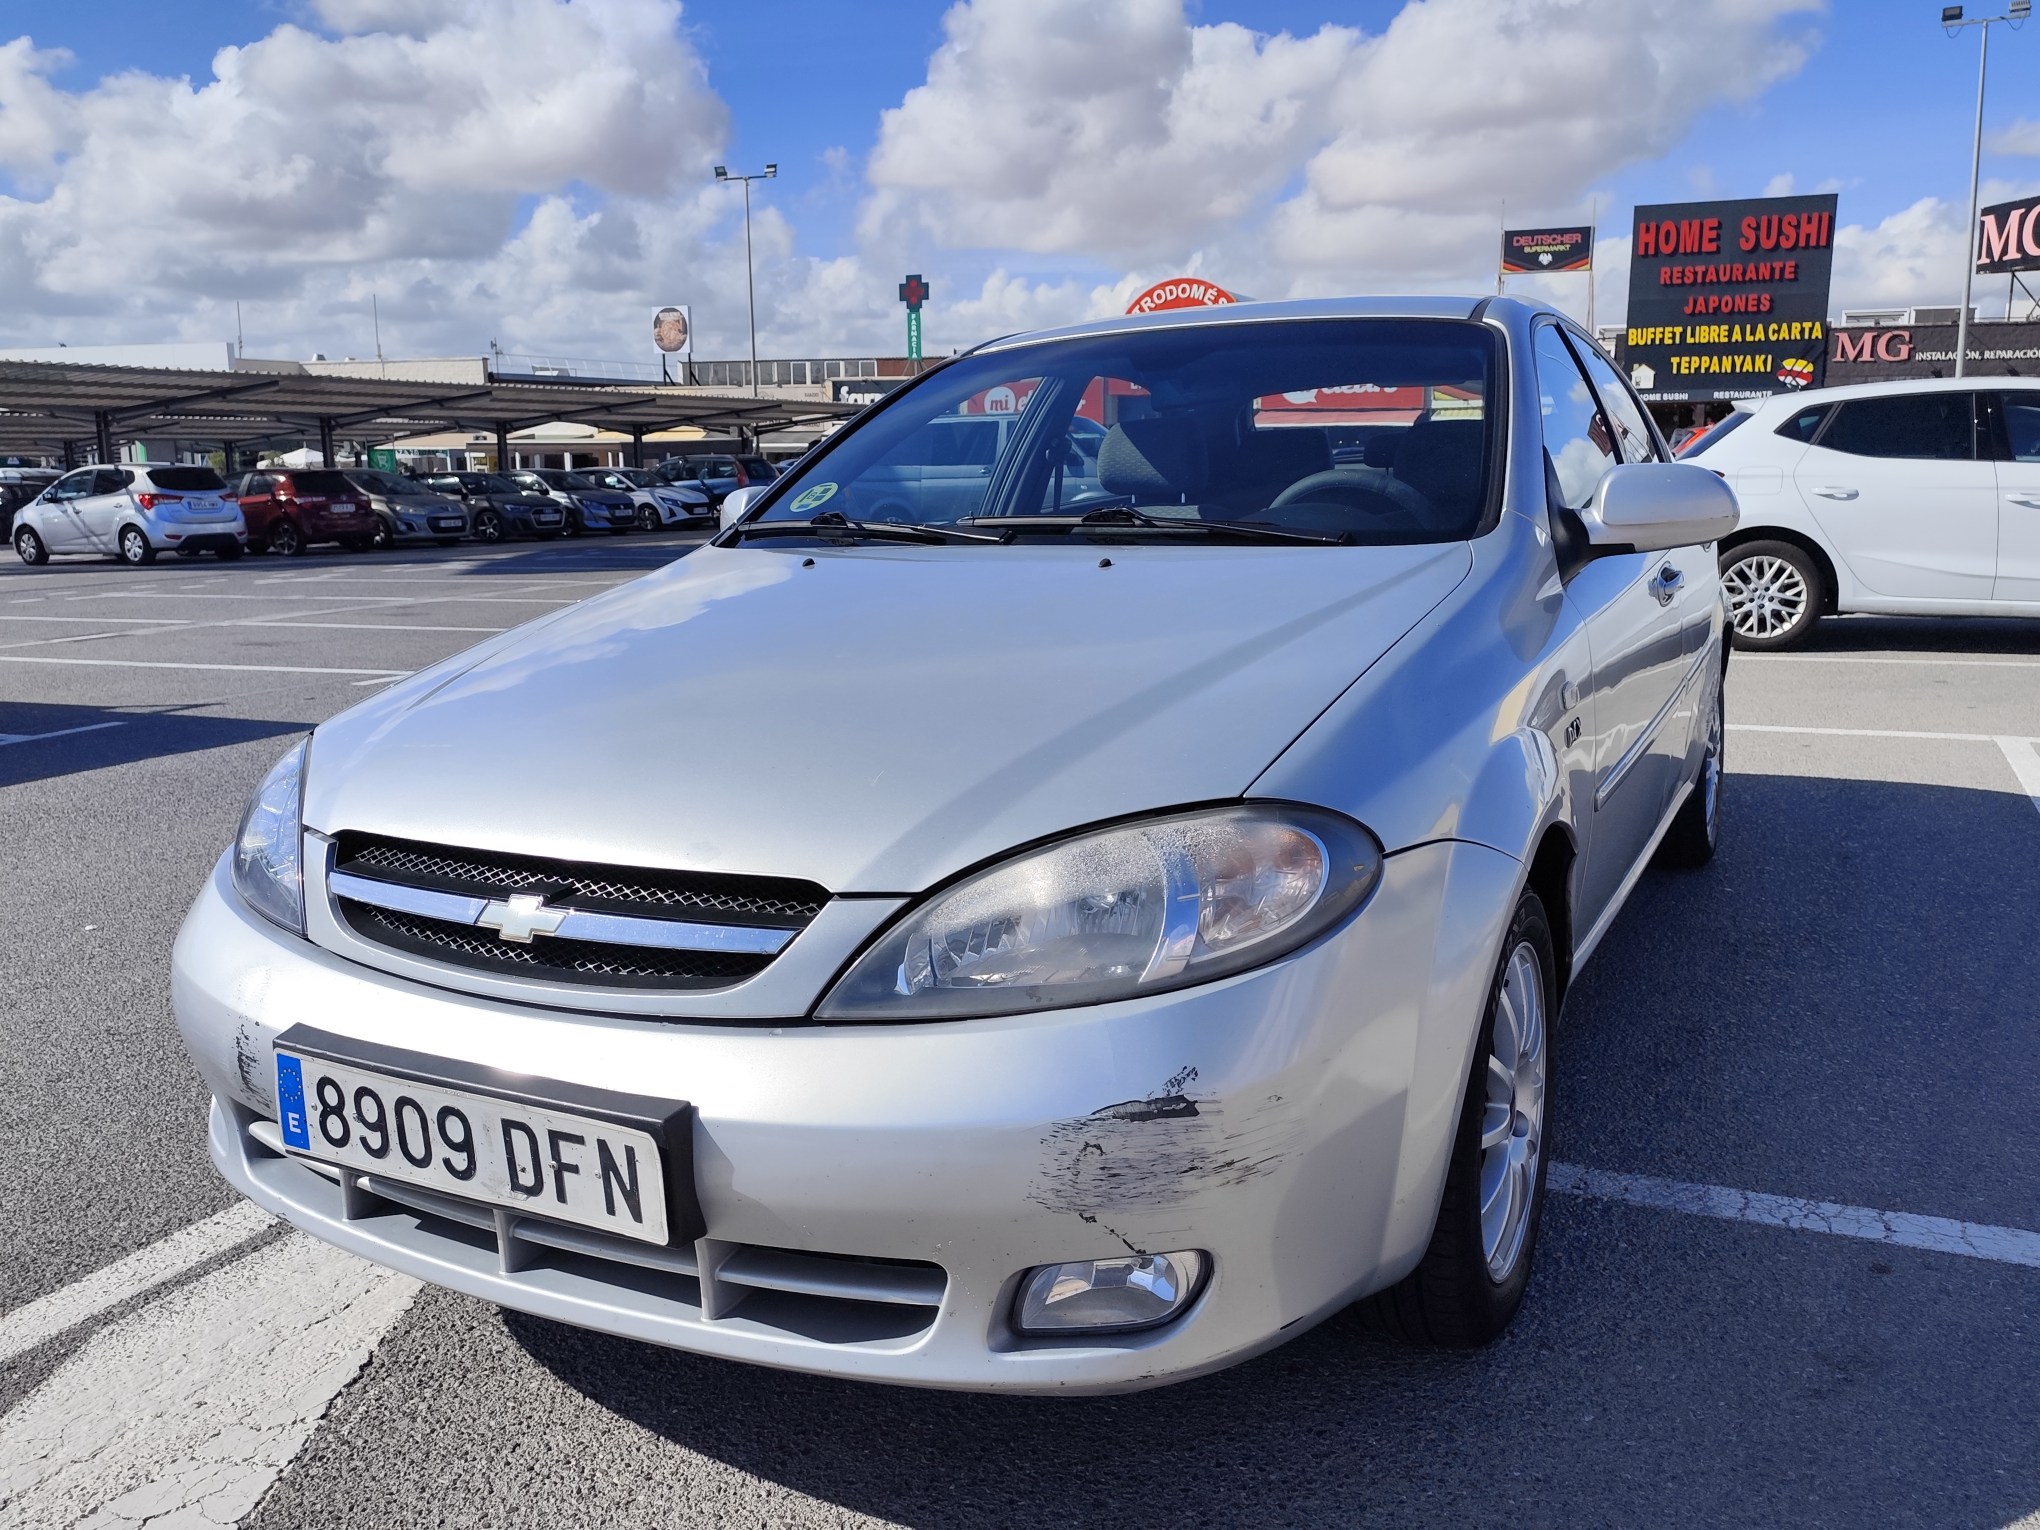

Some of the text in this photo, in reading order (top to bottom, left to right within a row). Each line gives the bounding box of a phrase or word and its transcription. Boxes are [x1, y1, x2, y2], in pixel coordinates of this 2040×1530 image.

[1513, 233, 1581, 247] DEUTSCHER
[1638, 212, 1830, 256] HOME SUSHI
[1524, 244, 1571, 253] SUPERMARKT
[1659, 260, 1797, 285] RESTAURANTE
[1684, 293, 1772, 315] JAPONES
[910, 313, 918, 358] FARMACIA
[1628, 321, 1823, 346] BUFFET LIBRE A LA CARTA
[1832, 330, 1914, 362] MG
[1915, 347, 2040, 361] INSTALACÓN, REPARACIÓ
[1670, 354, 1773, 375] TEPPANYAKI
[990, 395, 1010, 412] mi
[1662, 392, 1689, 401] SUSHI
[1713, 390, 1772, 400] RESTAURANTE
[288, 1112, 301, 1134] E
[316, 1076, 643, 1224] 8909 DFN
